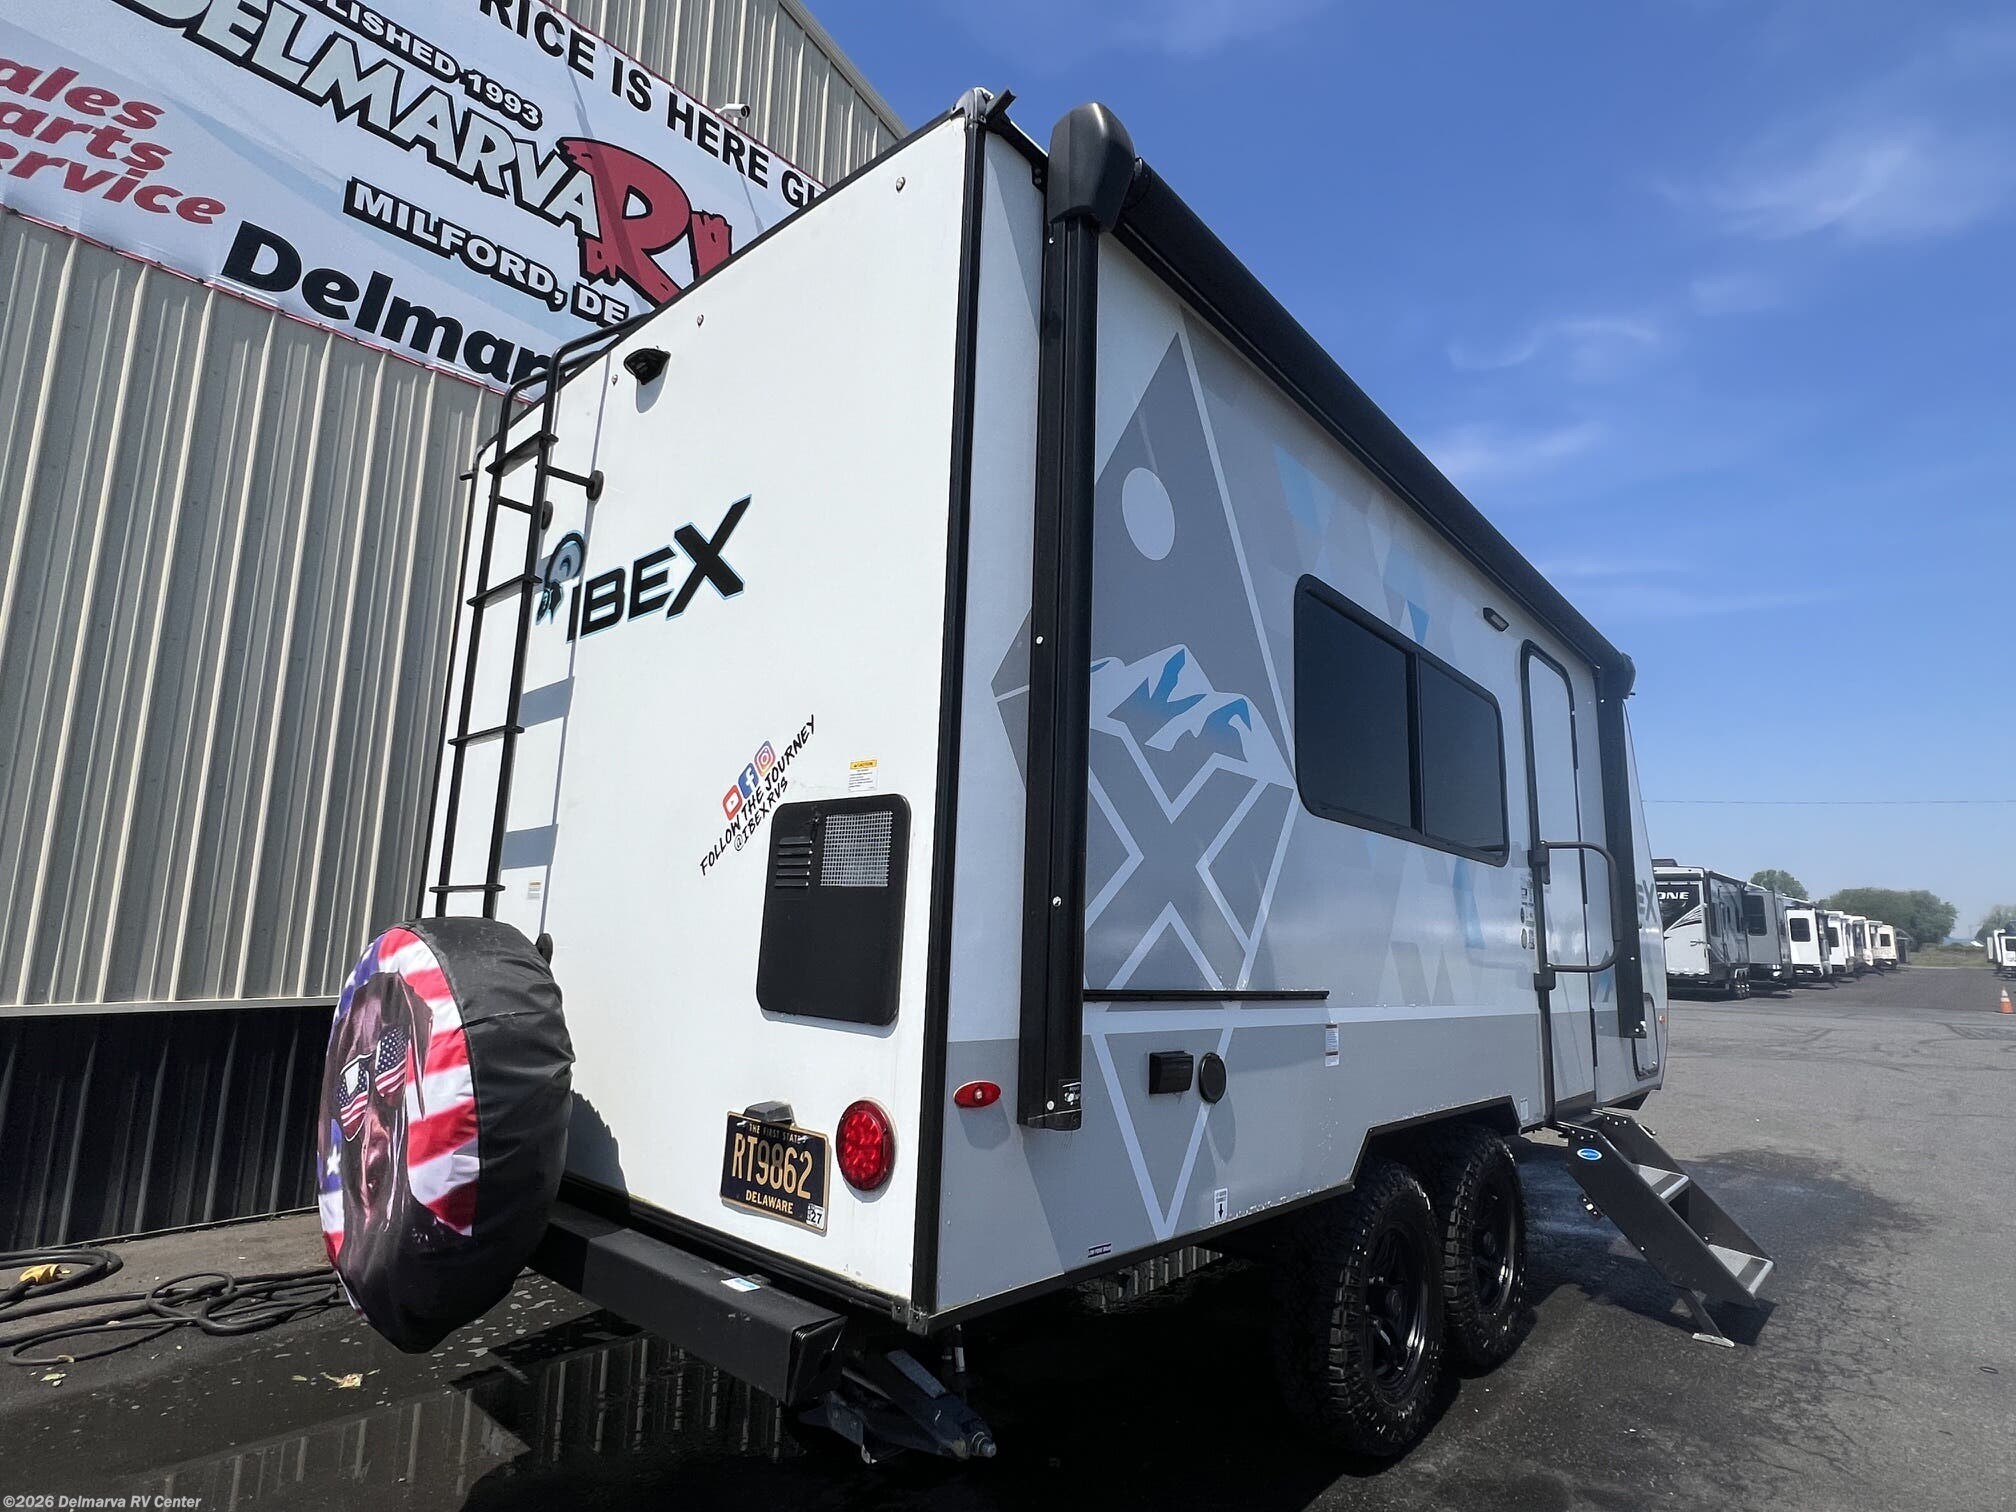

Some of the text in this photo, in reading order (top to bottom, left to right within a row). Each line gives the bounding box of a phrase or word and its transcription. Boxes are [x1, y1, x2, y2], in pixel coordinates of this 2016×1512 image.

[318, 0, 542, 127] LISHED 1993
[611, 57, 653, 112] IS
[666, 91, 769, 189] HERE
[345, 178, 629, 328] MILFORD, DE
[566, 494, 752, 643] IBEX
[700, 714, 815, 876] FOLLOW THE JOURNEY
[732, 1132, 813, 1199] RT9862
[749, 1123, 761, 1134] THE
[763, 1126, 780, 1138] FIRST
[745, 1189, 794, 1214] DELAWARE
[811, 1208, 823, 1224] 27
